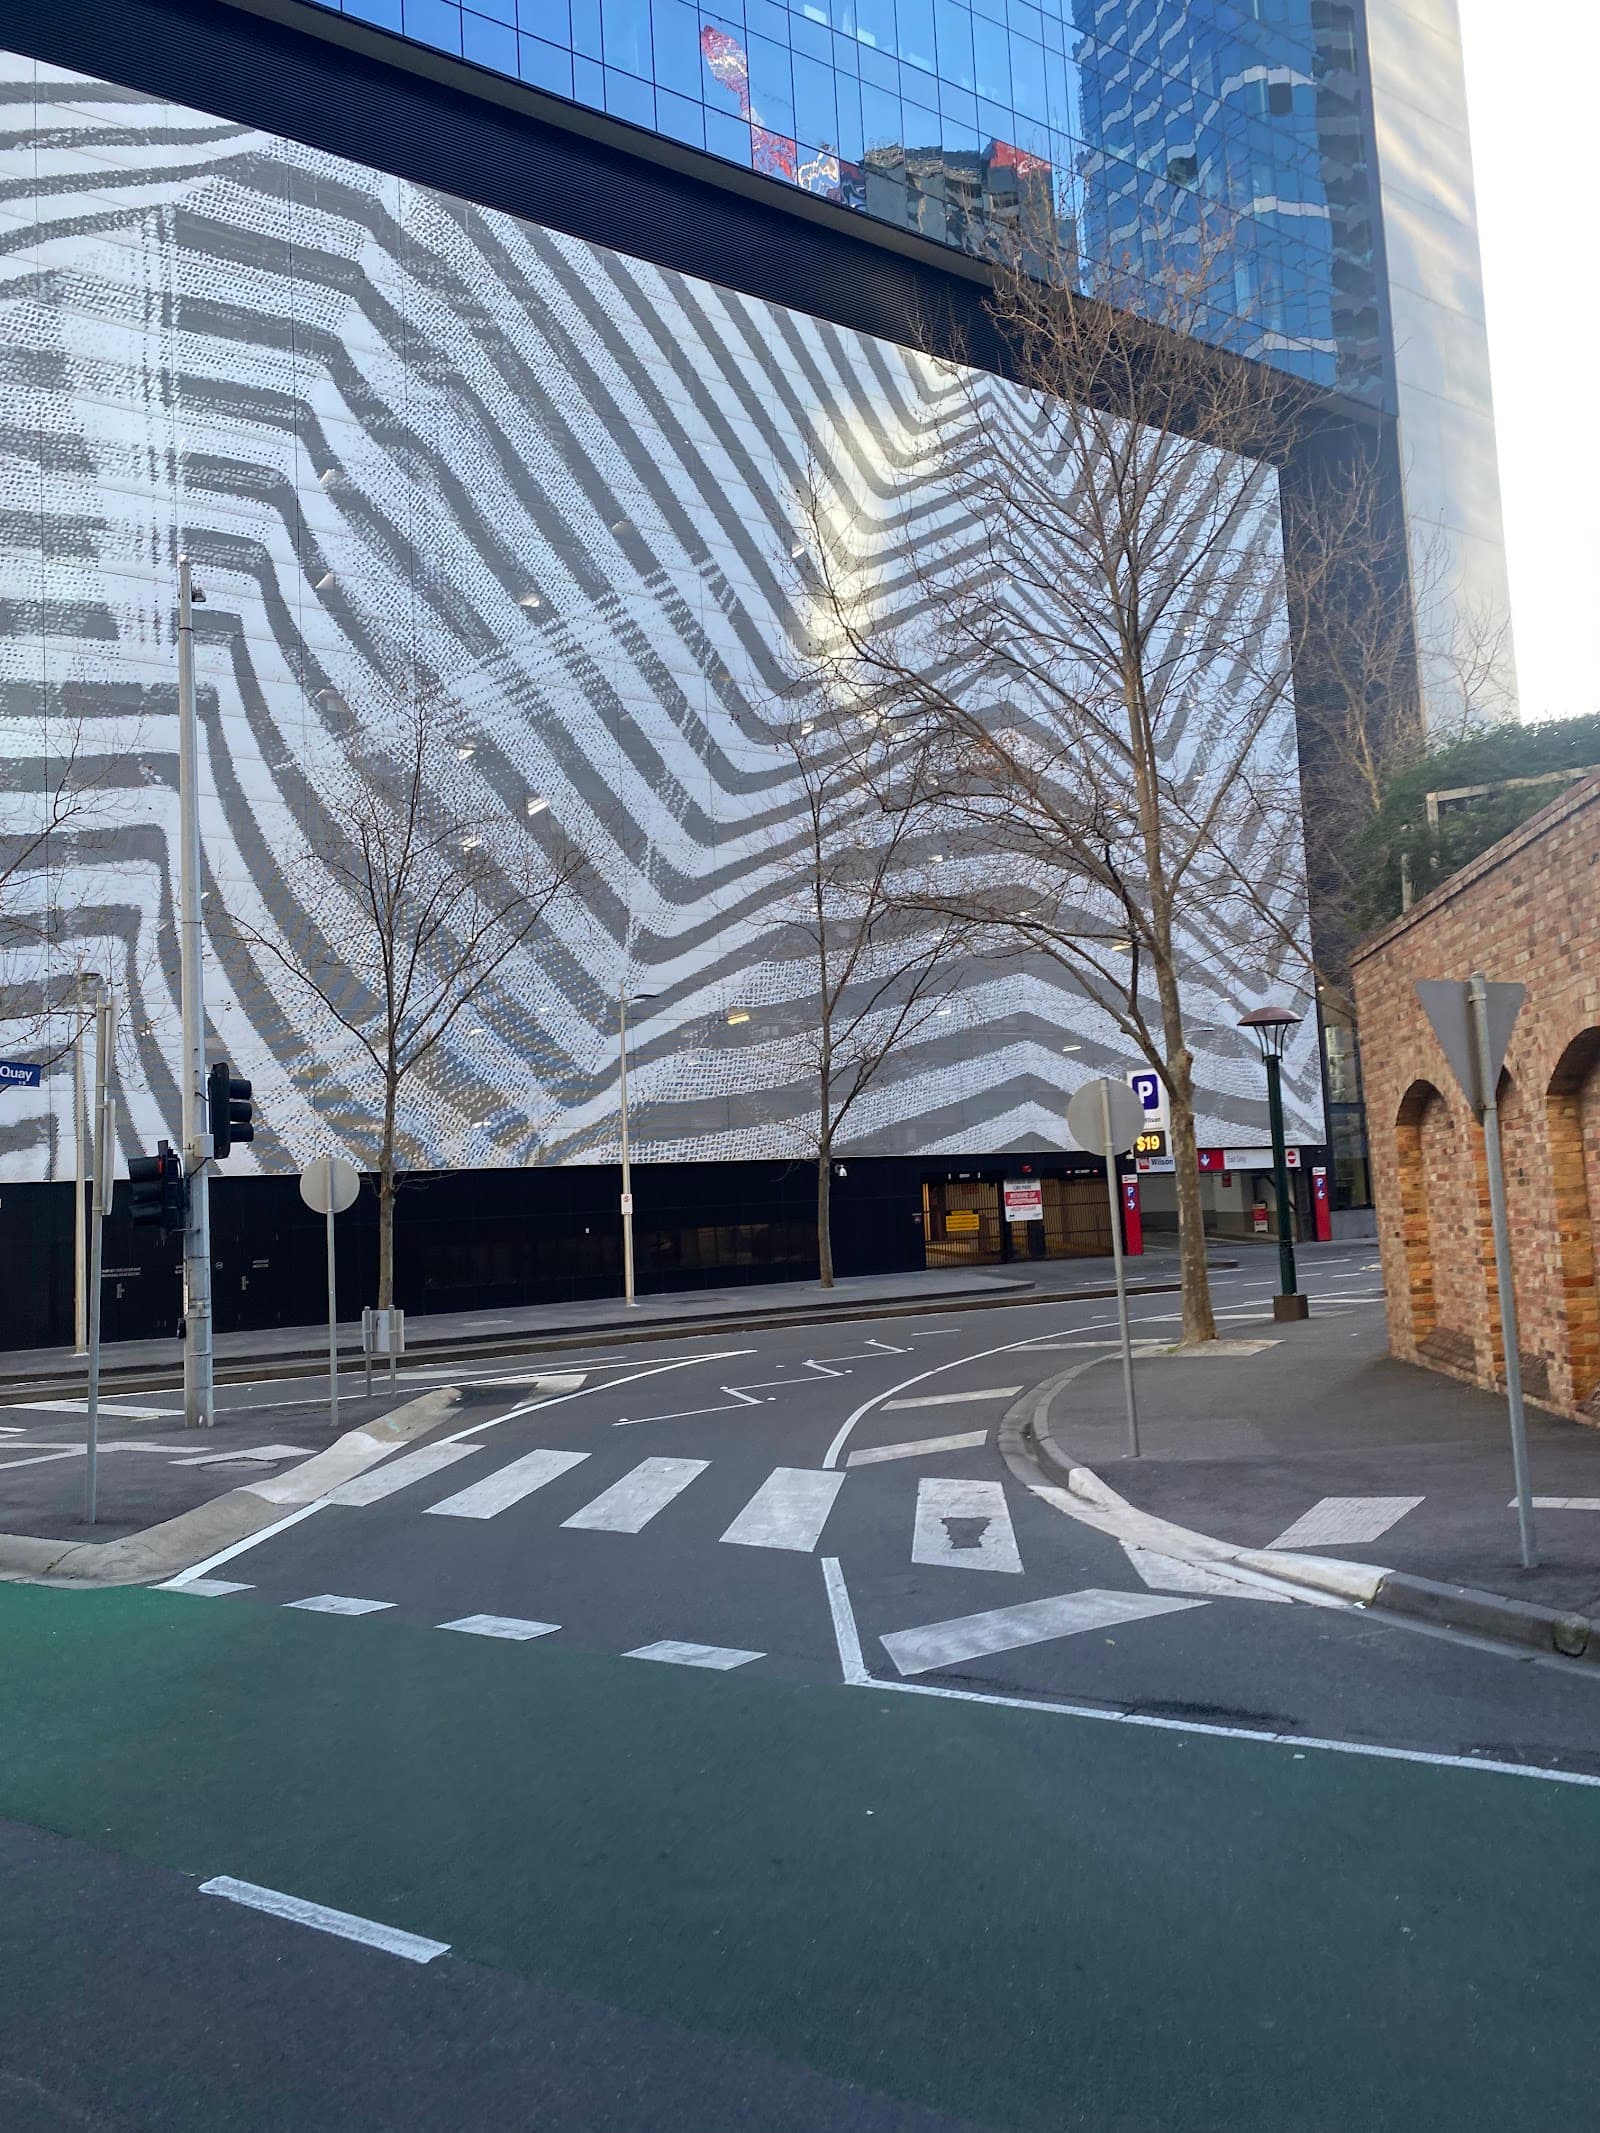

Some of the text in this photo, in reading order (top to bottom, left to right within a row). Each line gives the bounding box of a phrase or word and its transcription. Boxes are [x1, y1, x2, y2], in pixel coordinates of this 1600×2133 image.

[0, 1066, 33, 1082] Quay
[1137, 1081, 1153, 1104] P
[1137, 1135, 1160, 1152] $19
[1151, 1157, 1174, 1166] Wilson
[1317, 1178, 1323, 1187] P
[1127, 1186, 1134, 1196] P
